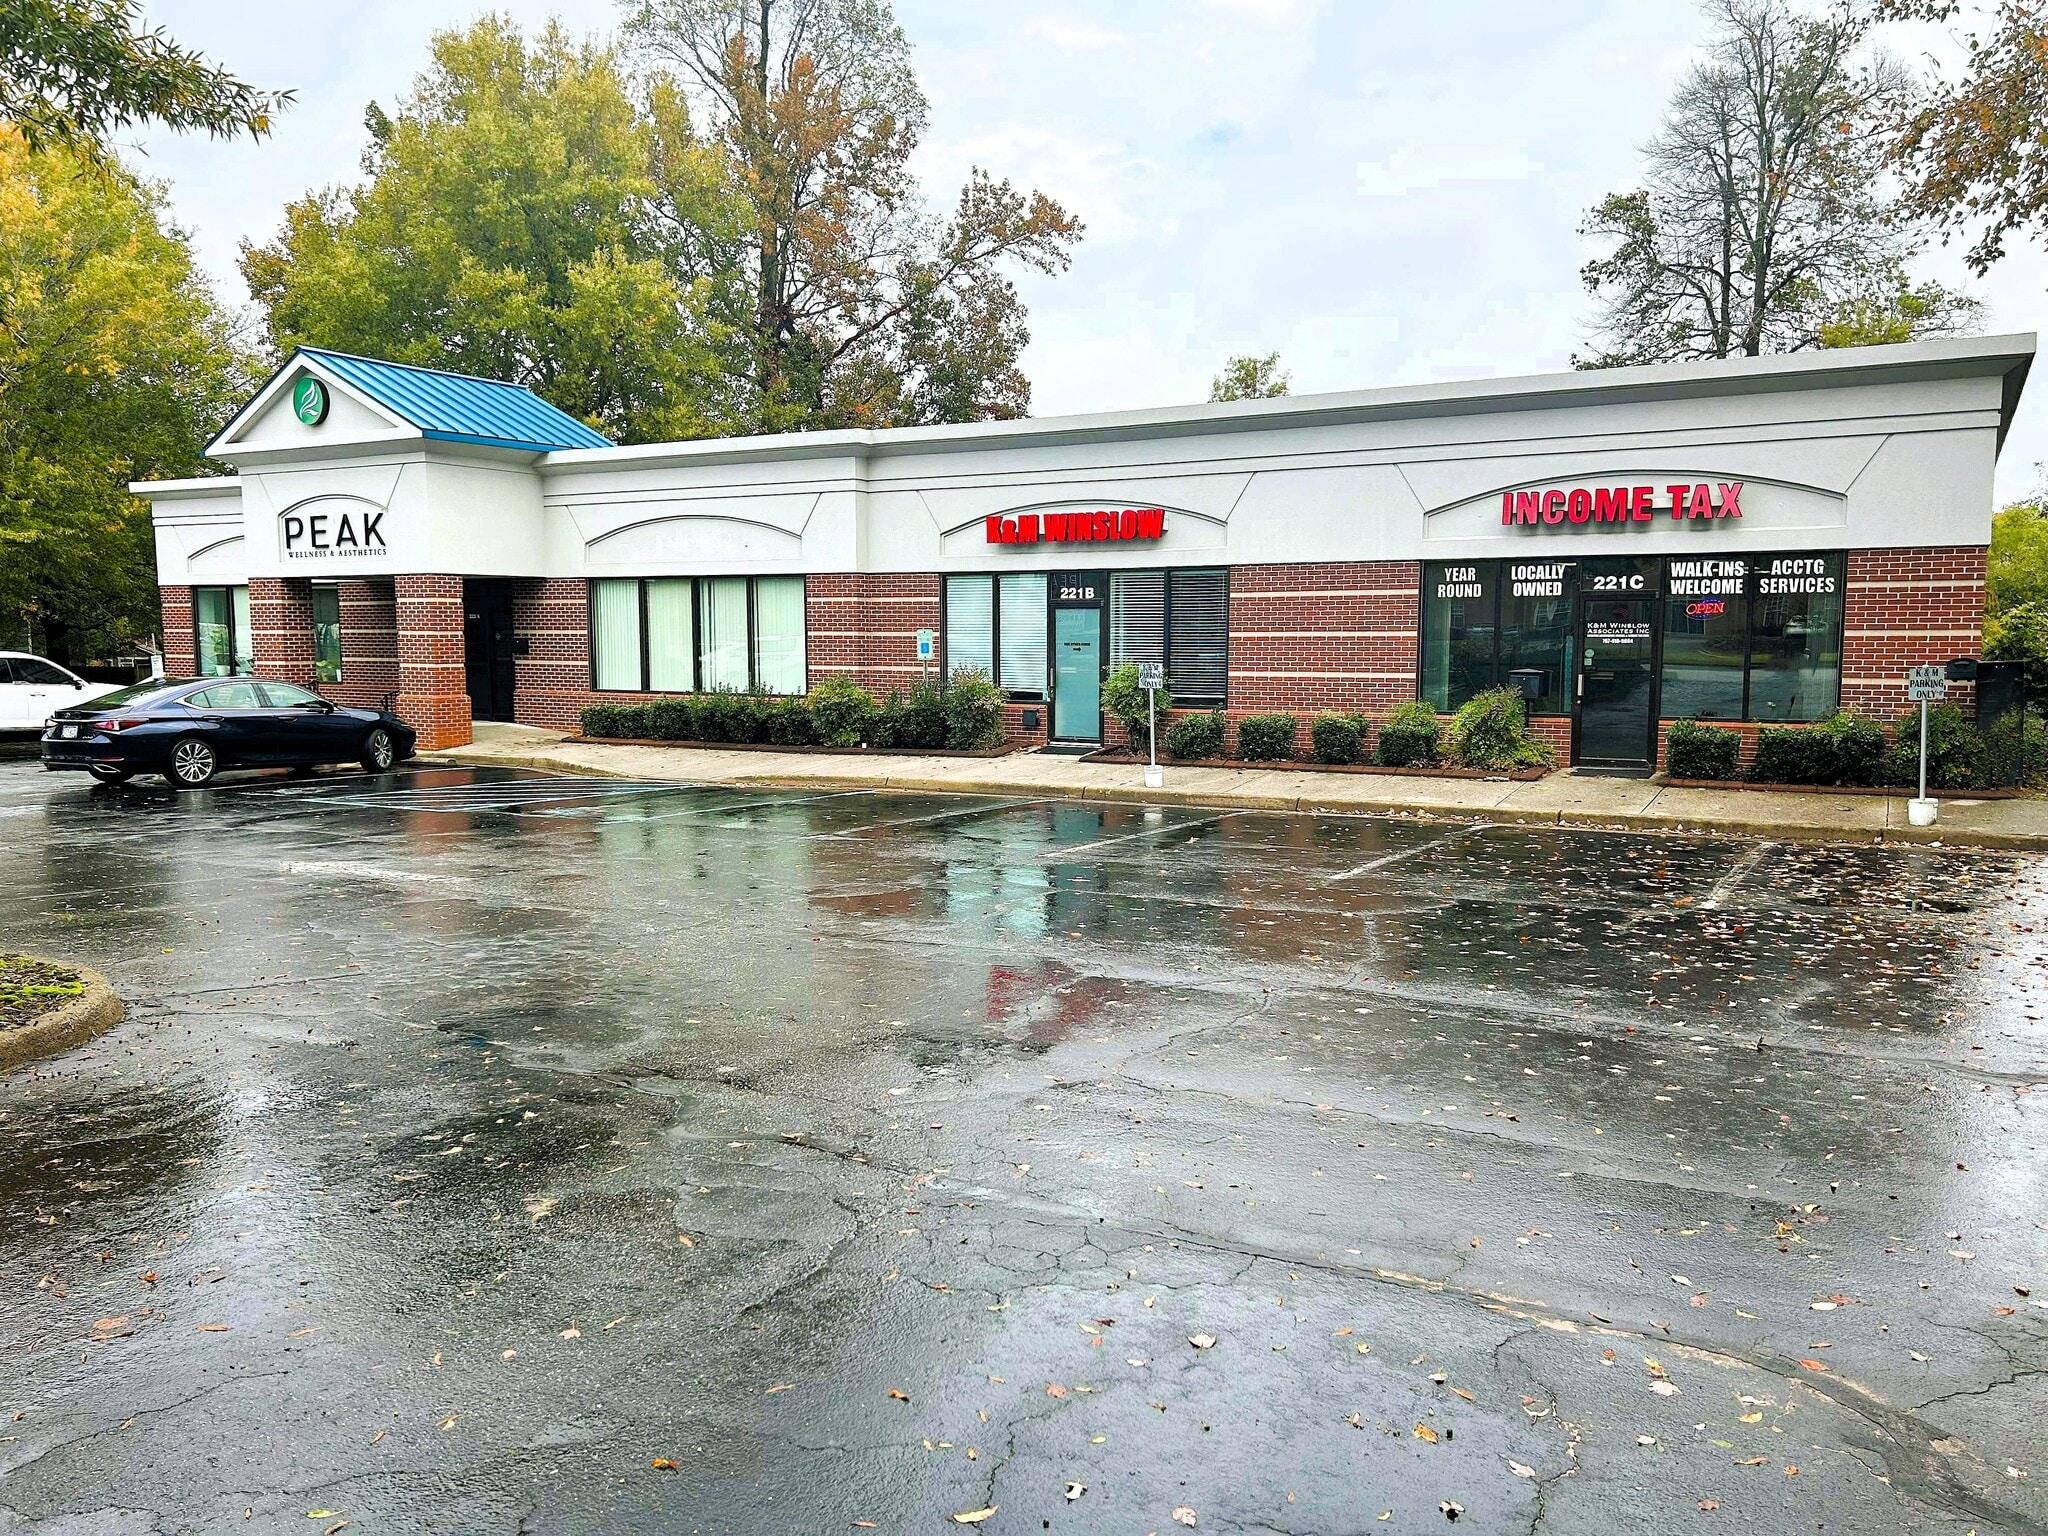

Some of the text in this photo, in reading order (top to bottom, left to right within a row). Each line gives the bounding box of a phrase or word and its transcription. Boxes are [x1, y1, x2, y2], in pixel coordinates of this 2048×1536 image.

[1502, 482, 1744, 526] INCOME TAX
[284, 512, 387, 550] PEAK
[986, 508, 1166, 544] K&M WINSLOW
[288, 550, 327, 559] WELLNESS
[338, 548, 388, 557] AESTHETICS
[1445, 567, 1476, 582] YEAR
[1511, 564, 1566, 580] LOCALLY
[1671, 560, 1744, 577] WALK-INS
[1771, 559, 1825, 575] ACCTG
[1513, 582, 1563, 597] OWNED
[1593, 575, 1645, 590] 221C
[1670, 578, 1744, 595] WELCOME
[1759, 577, 1836, 593] SERVICES
[1060, 587, 1095, 599] 221B
[1437, 583, 1482, 598] ROUND
[1686, 602, 1725, 616] OPEN
[1932, 669, 1939, 677] M
[1910, 679, 1944, 688] PARKING
[1916, 690, 1936, 699] ONLY
